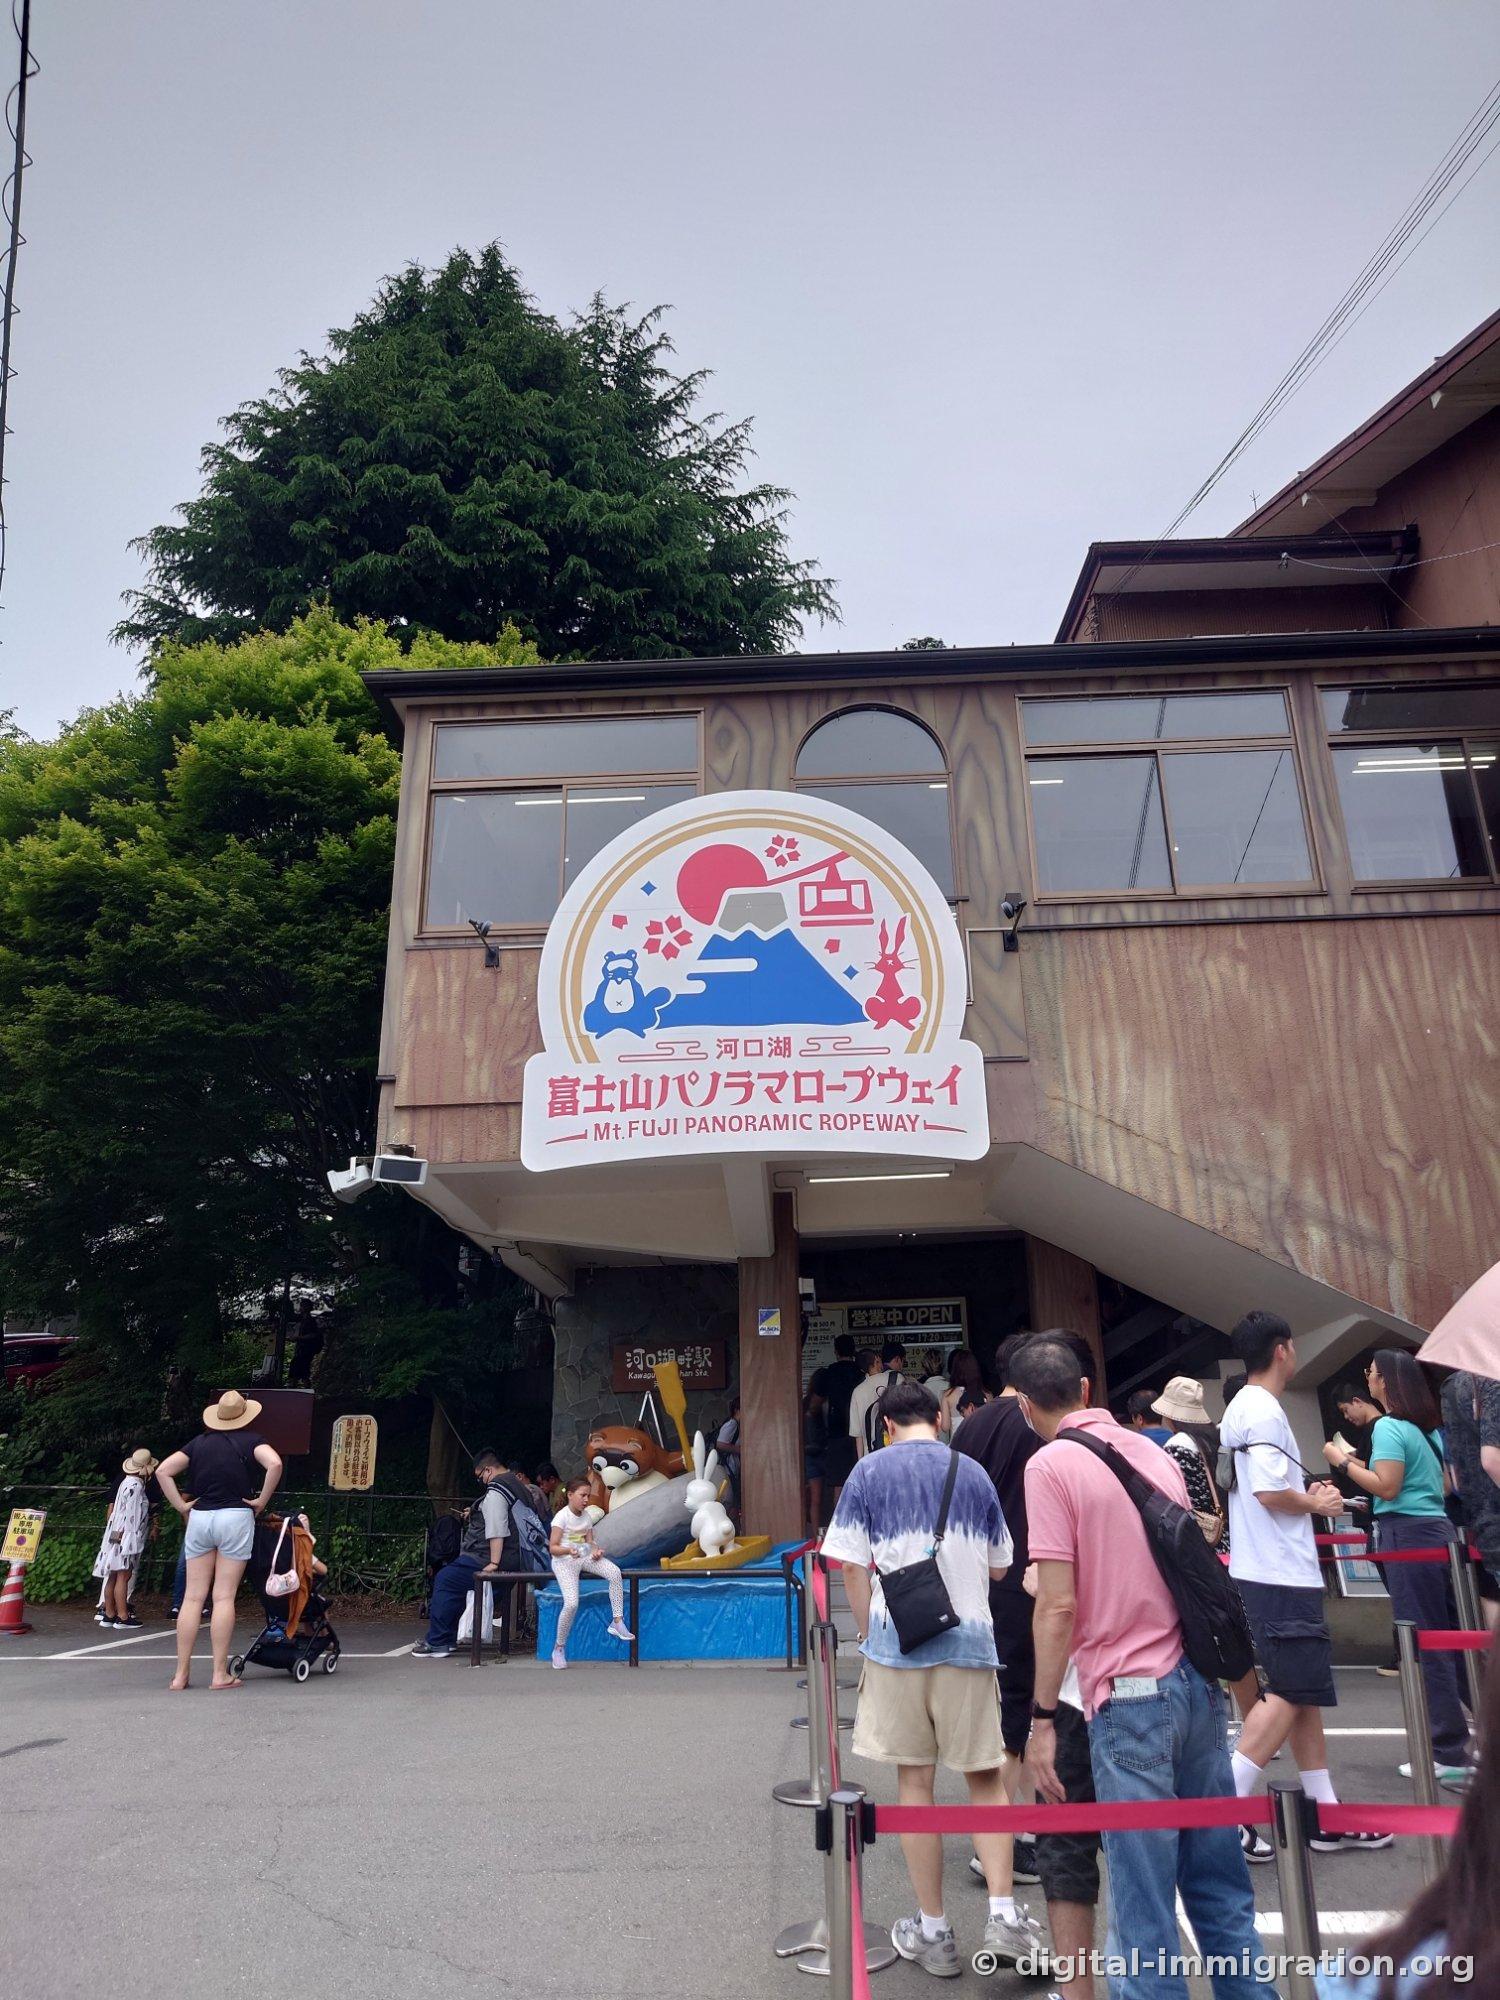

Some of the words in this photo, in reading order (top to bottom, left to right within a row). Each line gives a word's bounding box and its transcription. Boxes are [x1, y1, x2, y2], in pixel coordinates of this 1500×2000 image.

[716, 1036, 793, 1061] 河口湖
[547, 1064, 964, 1118] 富士山パノラマロープウェイ
[685, 1113, 813, 1135] PANORAMIC
[819, 1113, 921, 1133] ROPEWAY
[851, 1307, 903, 1327] 営業中
[906, 1306, 954, 1324] OPEN
[625, 1345, 713, 1371] 河口湖畔駅
